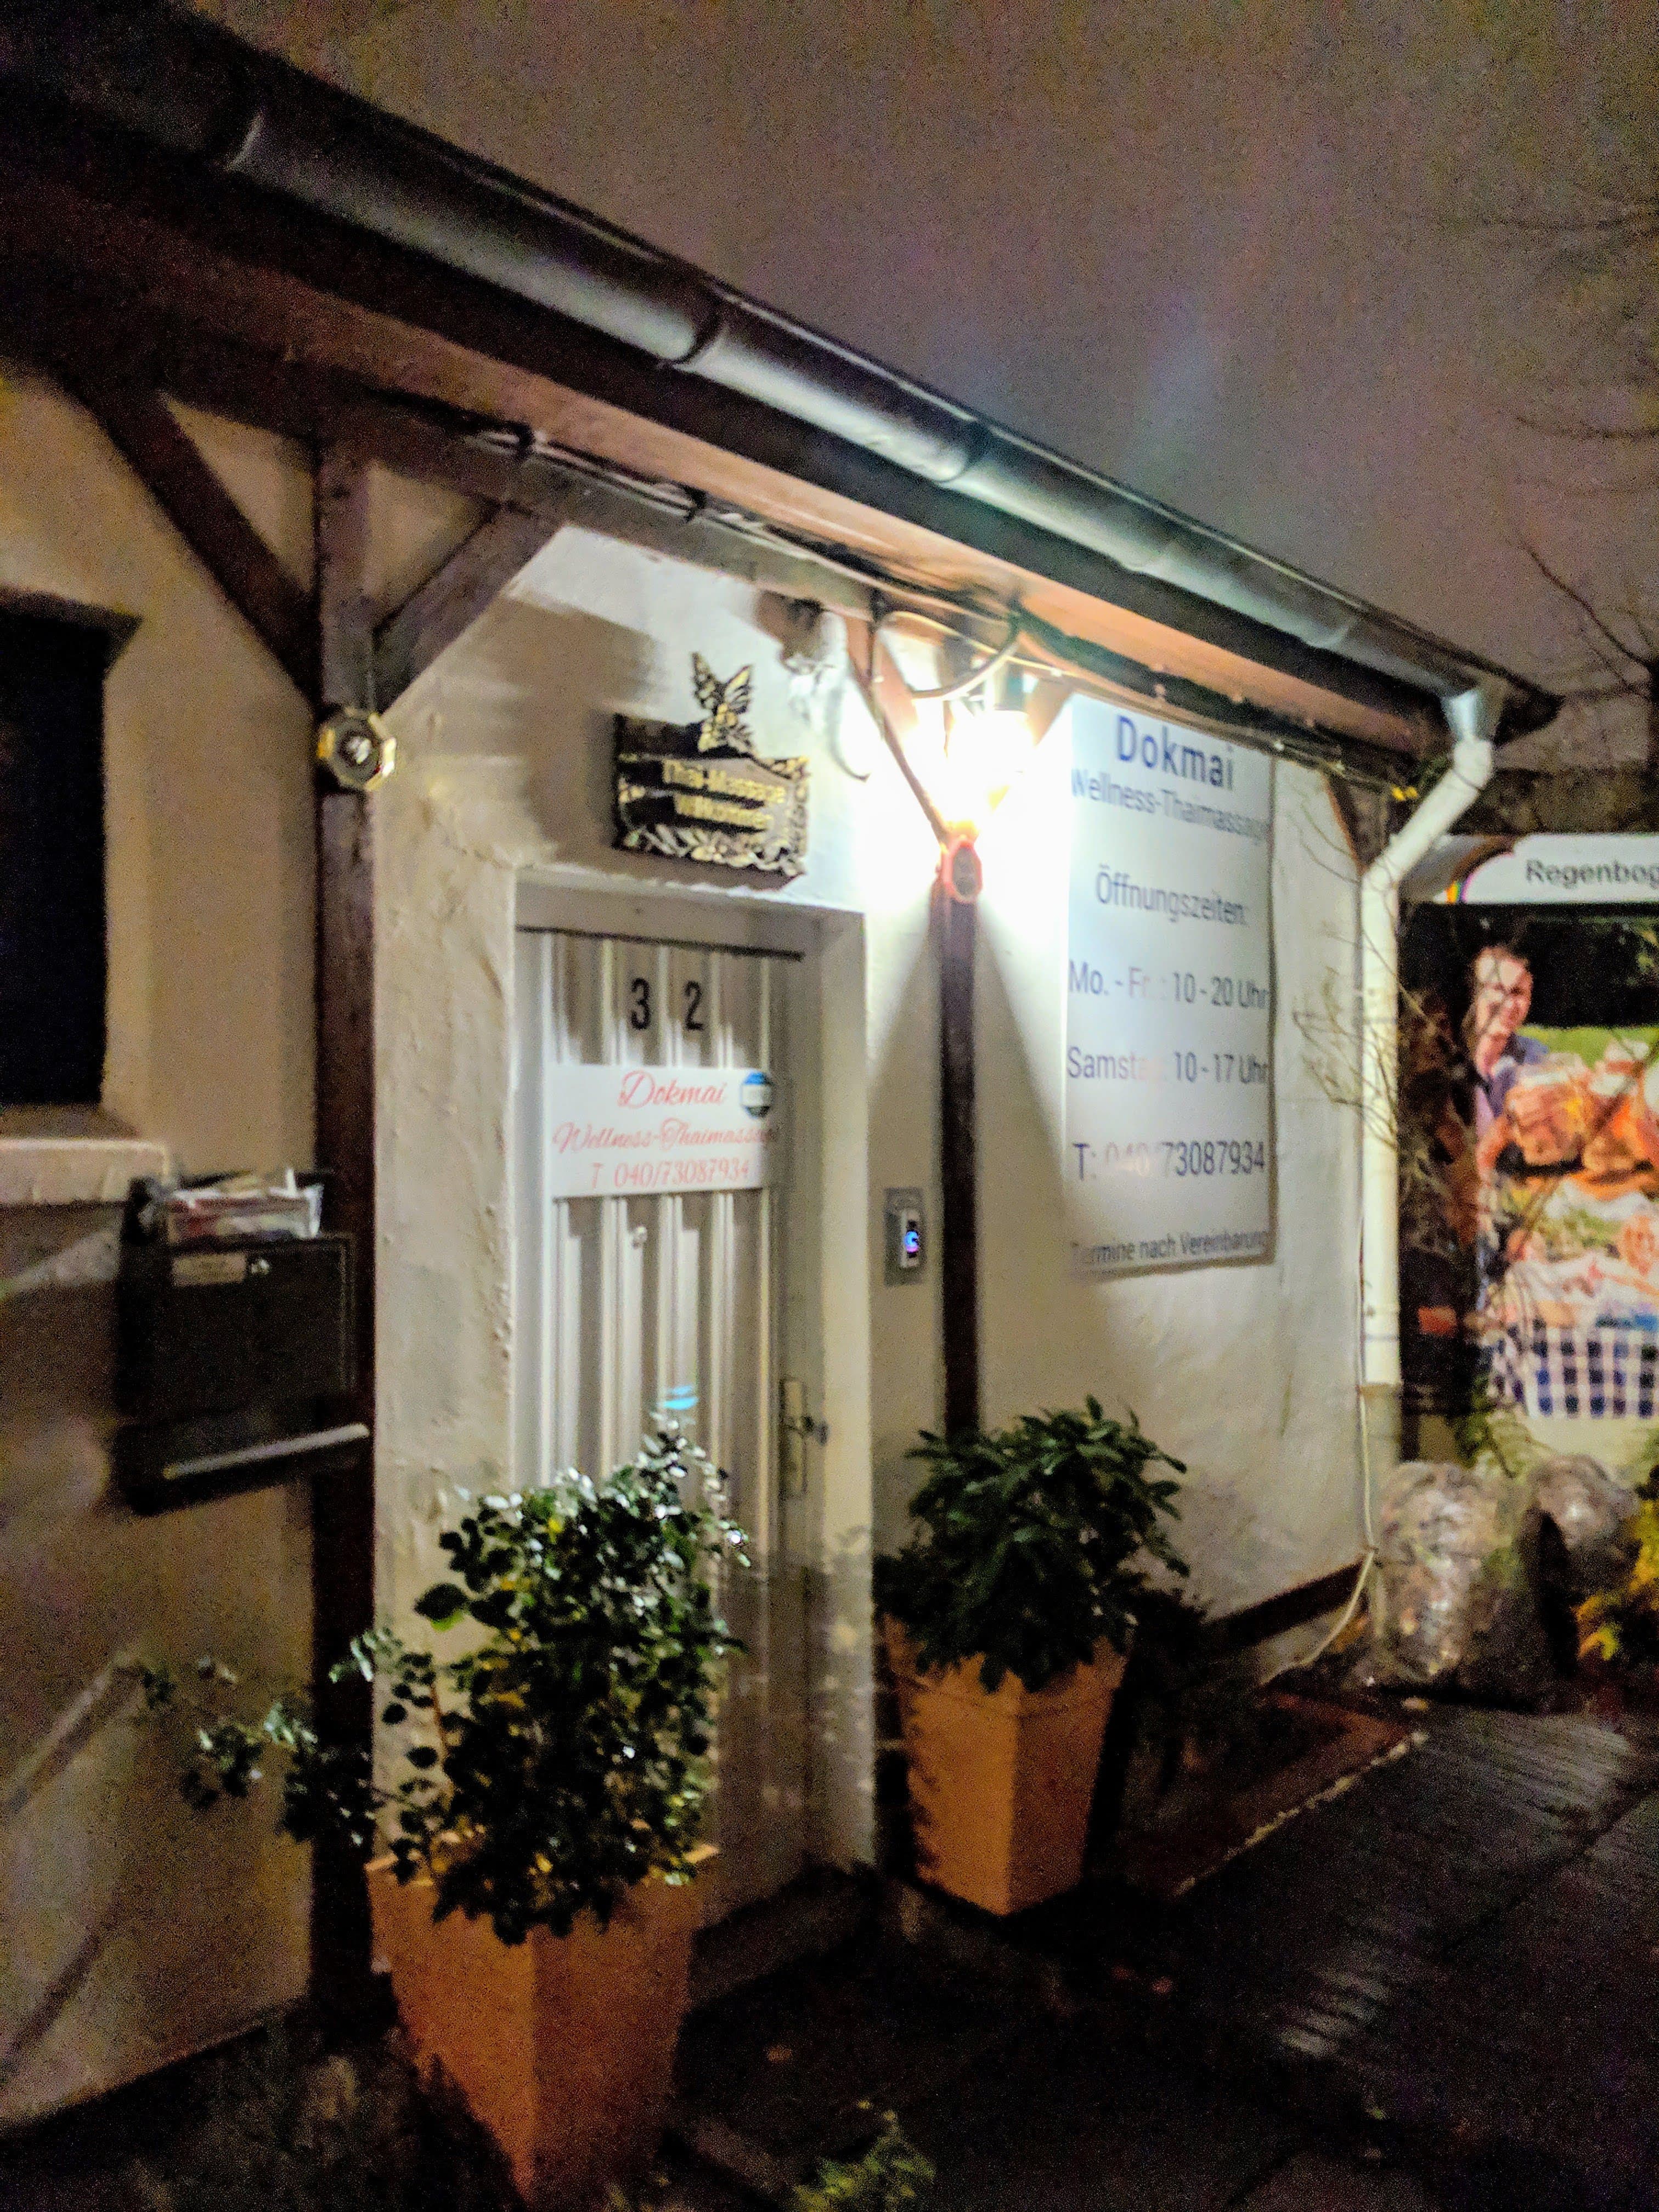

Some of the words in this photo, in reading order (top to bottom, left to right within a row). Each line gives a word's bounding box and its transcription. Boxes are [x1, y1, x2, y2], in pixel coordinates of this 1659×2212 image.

[1117, 715, 1234, 791] Dokmai
[1069, 959, 1109, 995] Mo.
[617, 1070, 728, 1109] Dokmai
